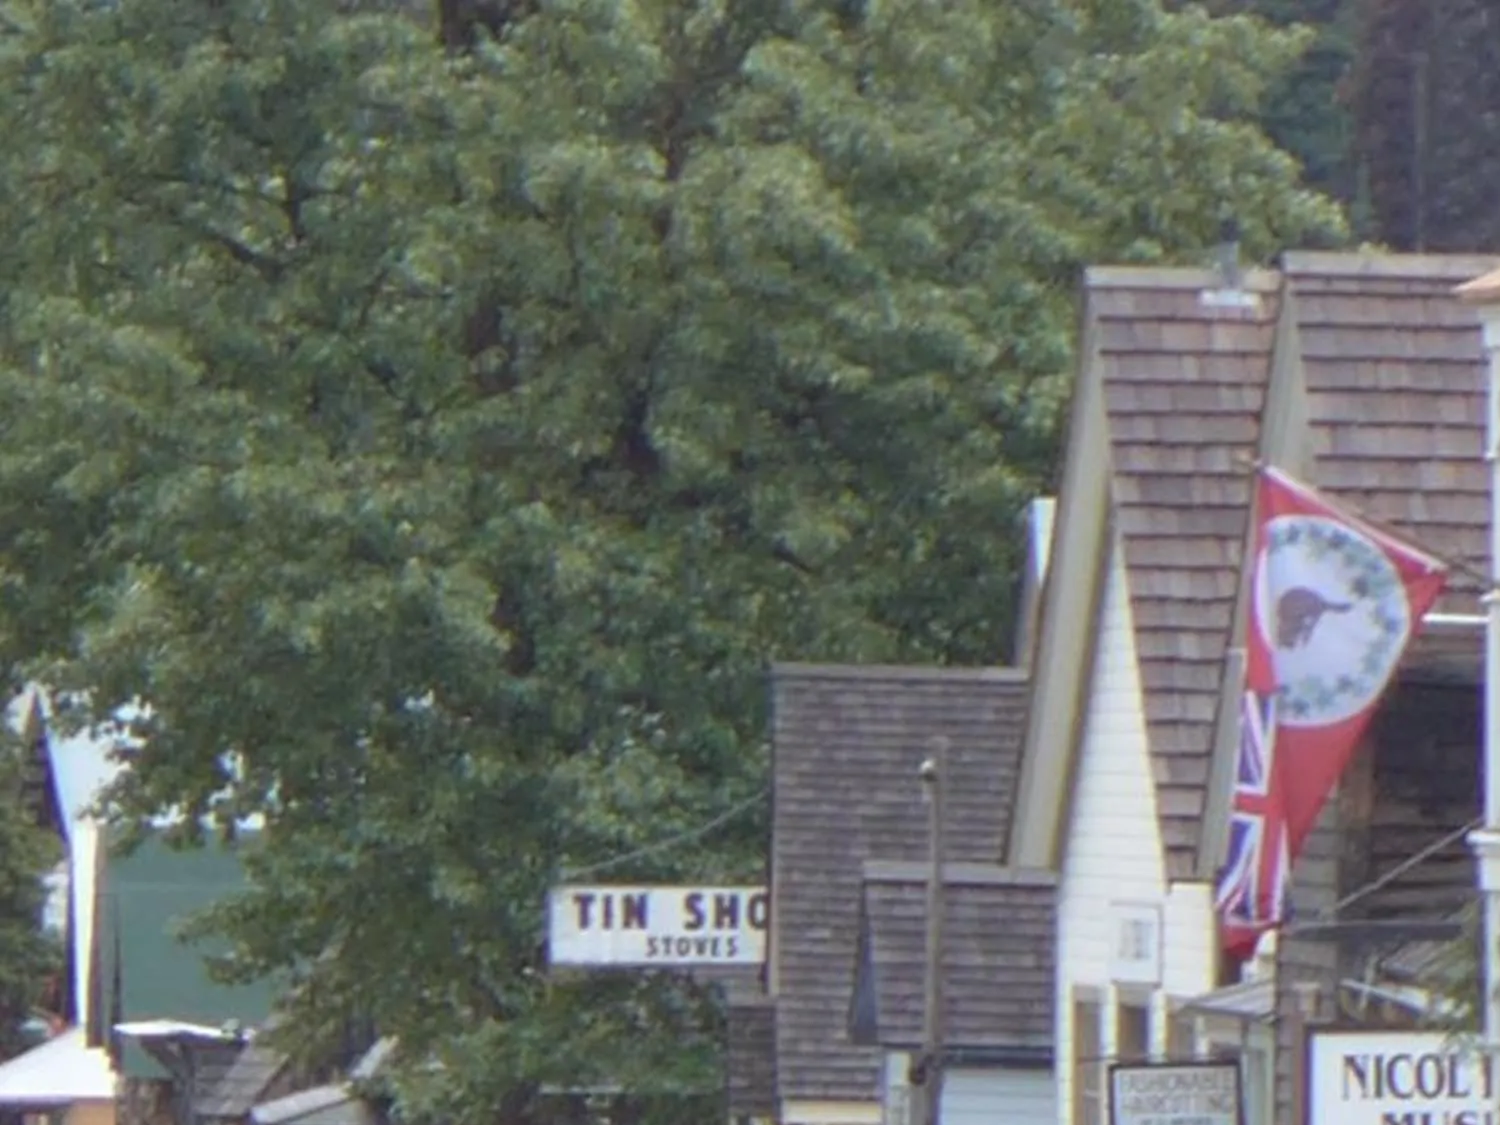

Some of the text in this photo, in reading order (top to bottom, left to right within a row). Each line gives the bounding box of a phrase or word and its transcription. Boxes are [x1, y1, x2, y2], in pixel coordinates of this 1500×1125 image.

[573, 892, 648, 930] TIN
[645, 935, 739, 958] STOVES
[1341, 1053, 1471, 1100] NICOL
